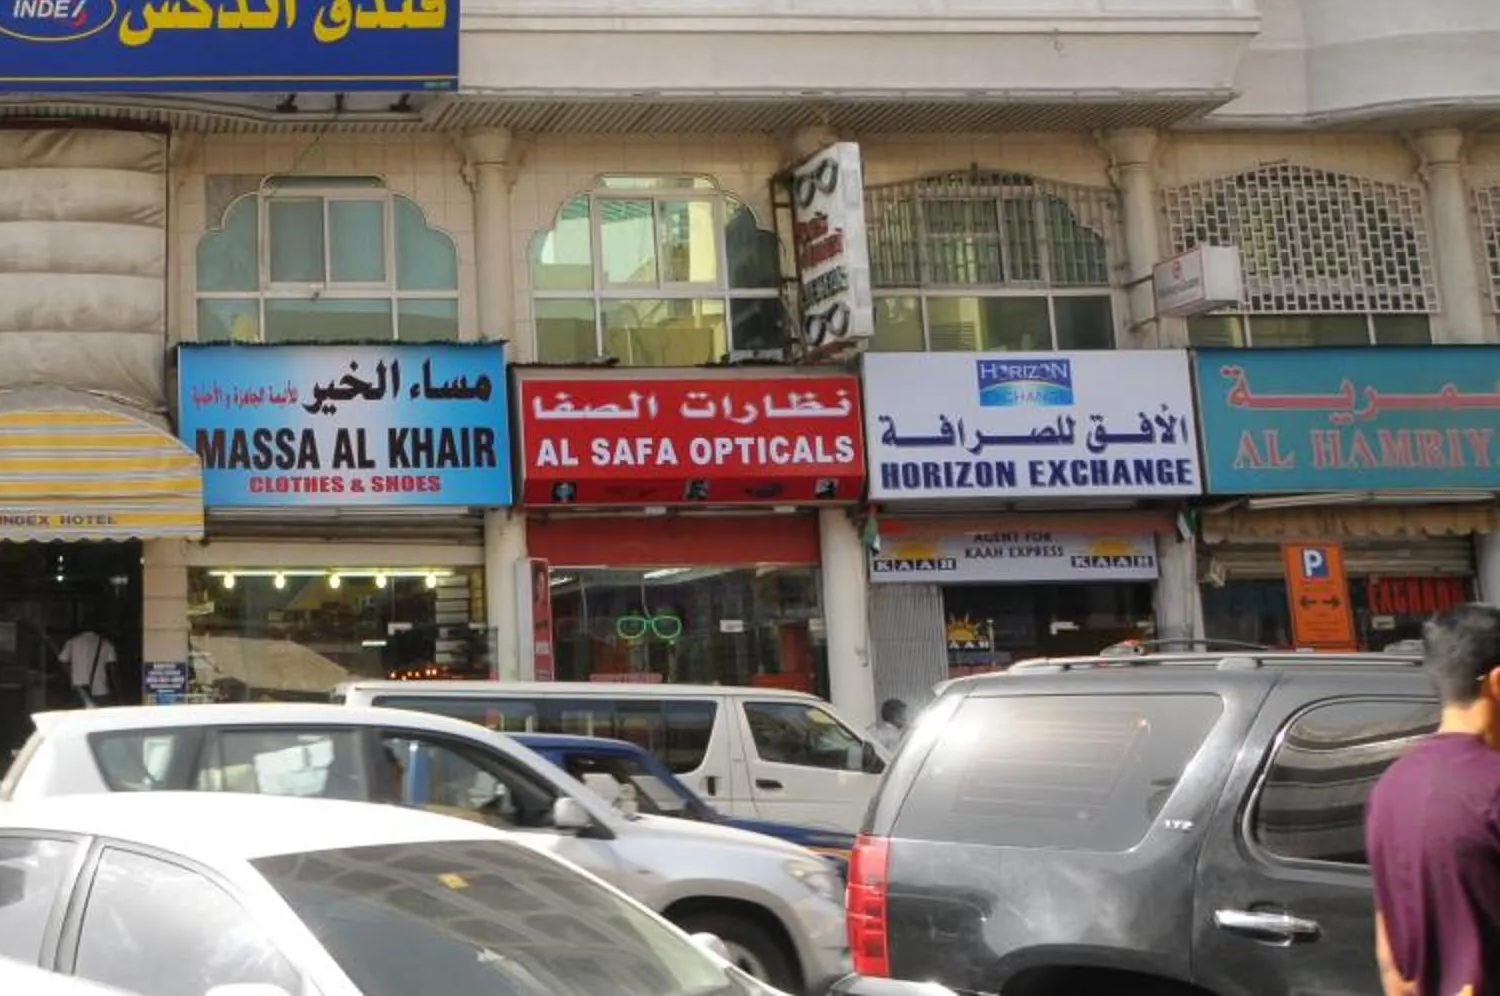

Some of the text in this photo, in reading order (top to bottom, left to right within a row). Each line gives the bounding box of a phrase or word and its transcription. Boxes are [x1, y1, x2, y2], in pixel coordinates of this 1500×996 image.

[980, 363, 1068, 380] HORIZON
[301, 358, 493, 416] مساء الخير
[532, 390, 853, 425] نظارات الصفا
[196, 426, 497, 471] MASSA AL KHAIR
[878, 413, 1077, 456] للصرافة
[1232, 428, 1500, 470] AL HAMRIY
[536, 435, 855, 467] AL SAFA OPTICALS
[250, 475, 442, 494] CLOTHES & SHOES
[880, 458, 1194, 490] HORIZON EXCHANGE
[60, 514, 115, 525] HOTEL
[964, 545, 1064, 558] KAAH EXPRESS
[1025, 532, 1052, 543] FOR
[875, 559, 955, 572] KAAH
[1072, 556, 1153, 568] KAAH
[1303, 549, 1323, 578] P
